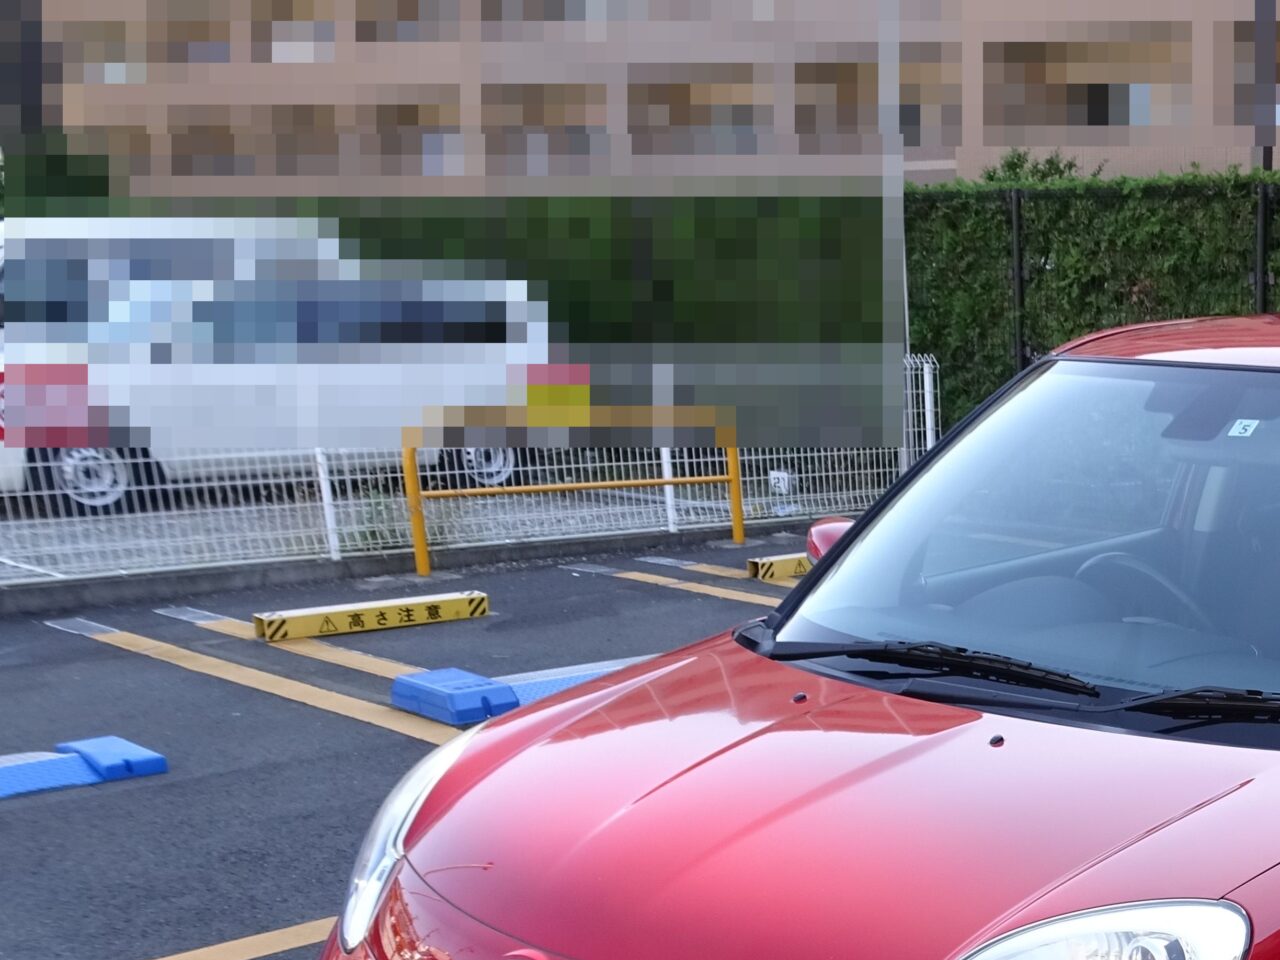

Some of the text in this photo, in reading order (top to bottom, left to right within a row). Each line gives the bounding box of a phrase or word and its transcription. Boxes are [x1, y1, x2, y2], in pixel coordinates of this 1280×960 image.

[1238, 424, 1252, 435] 5
[347, 604, 442, 629] 高さ注意
